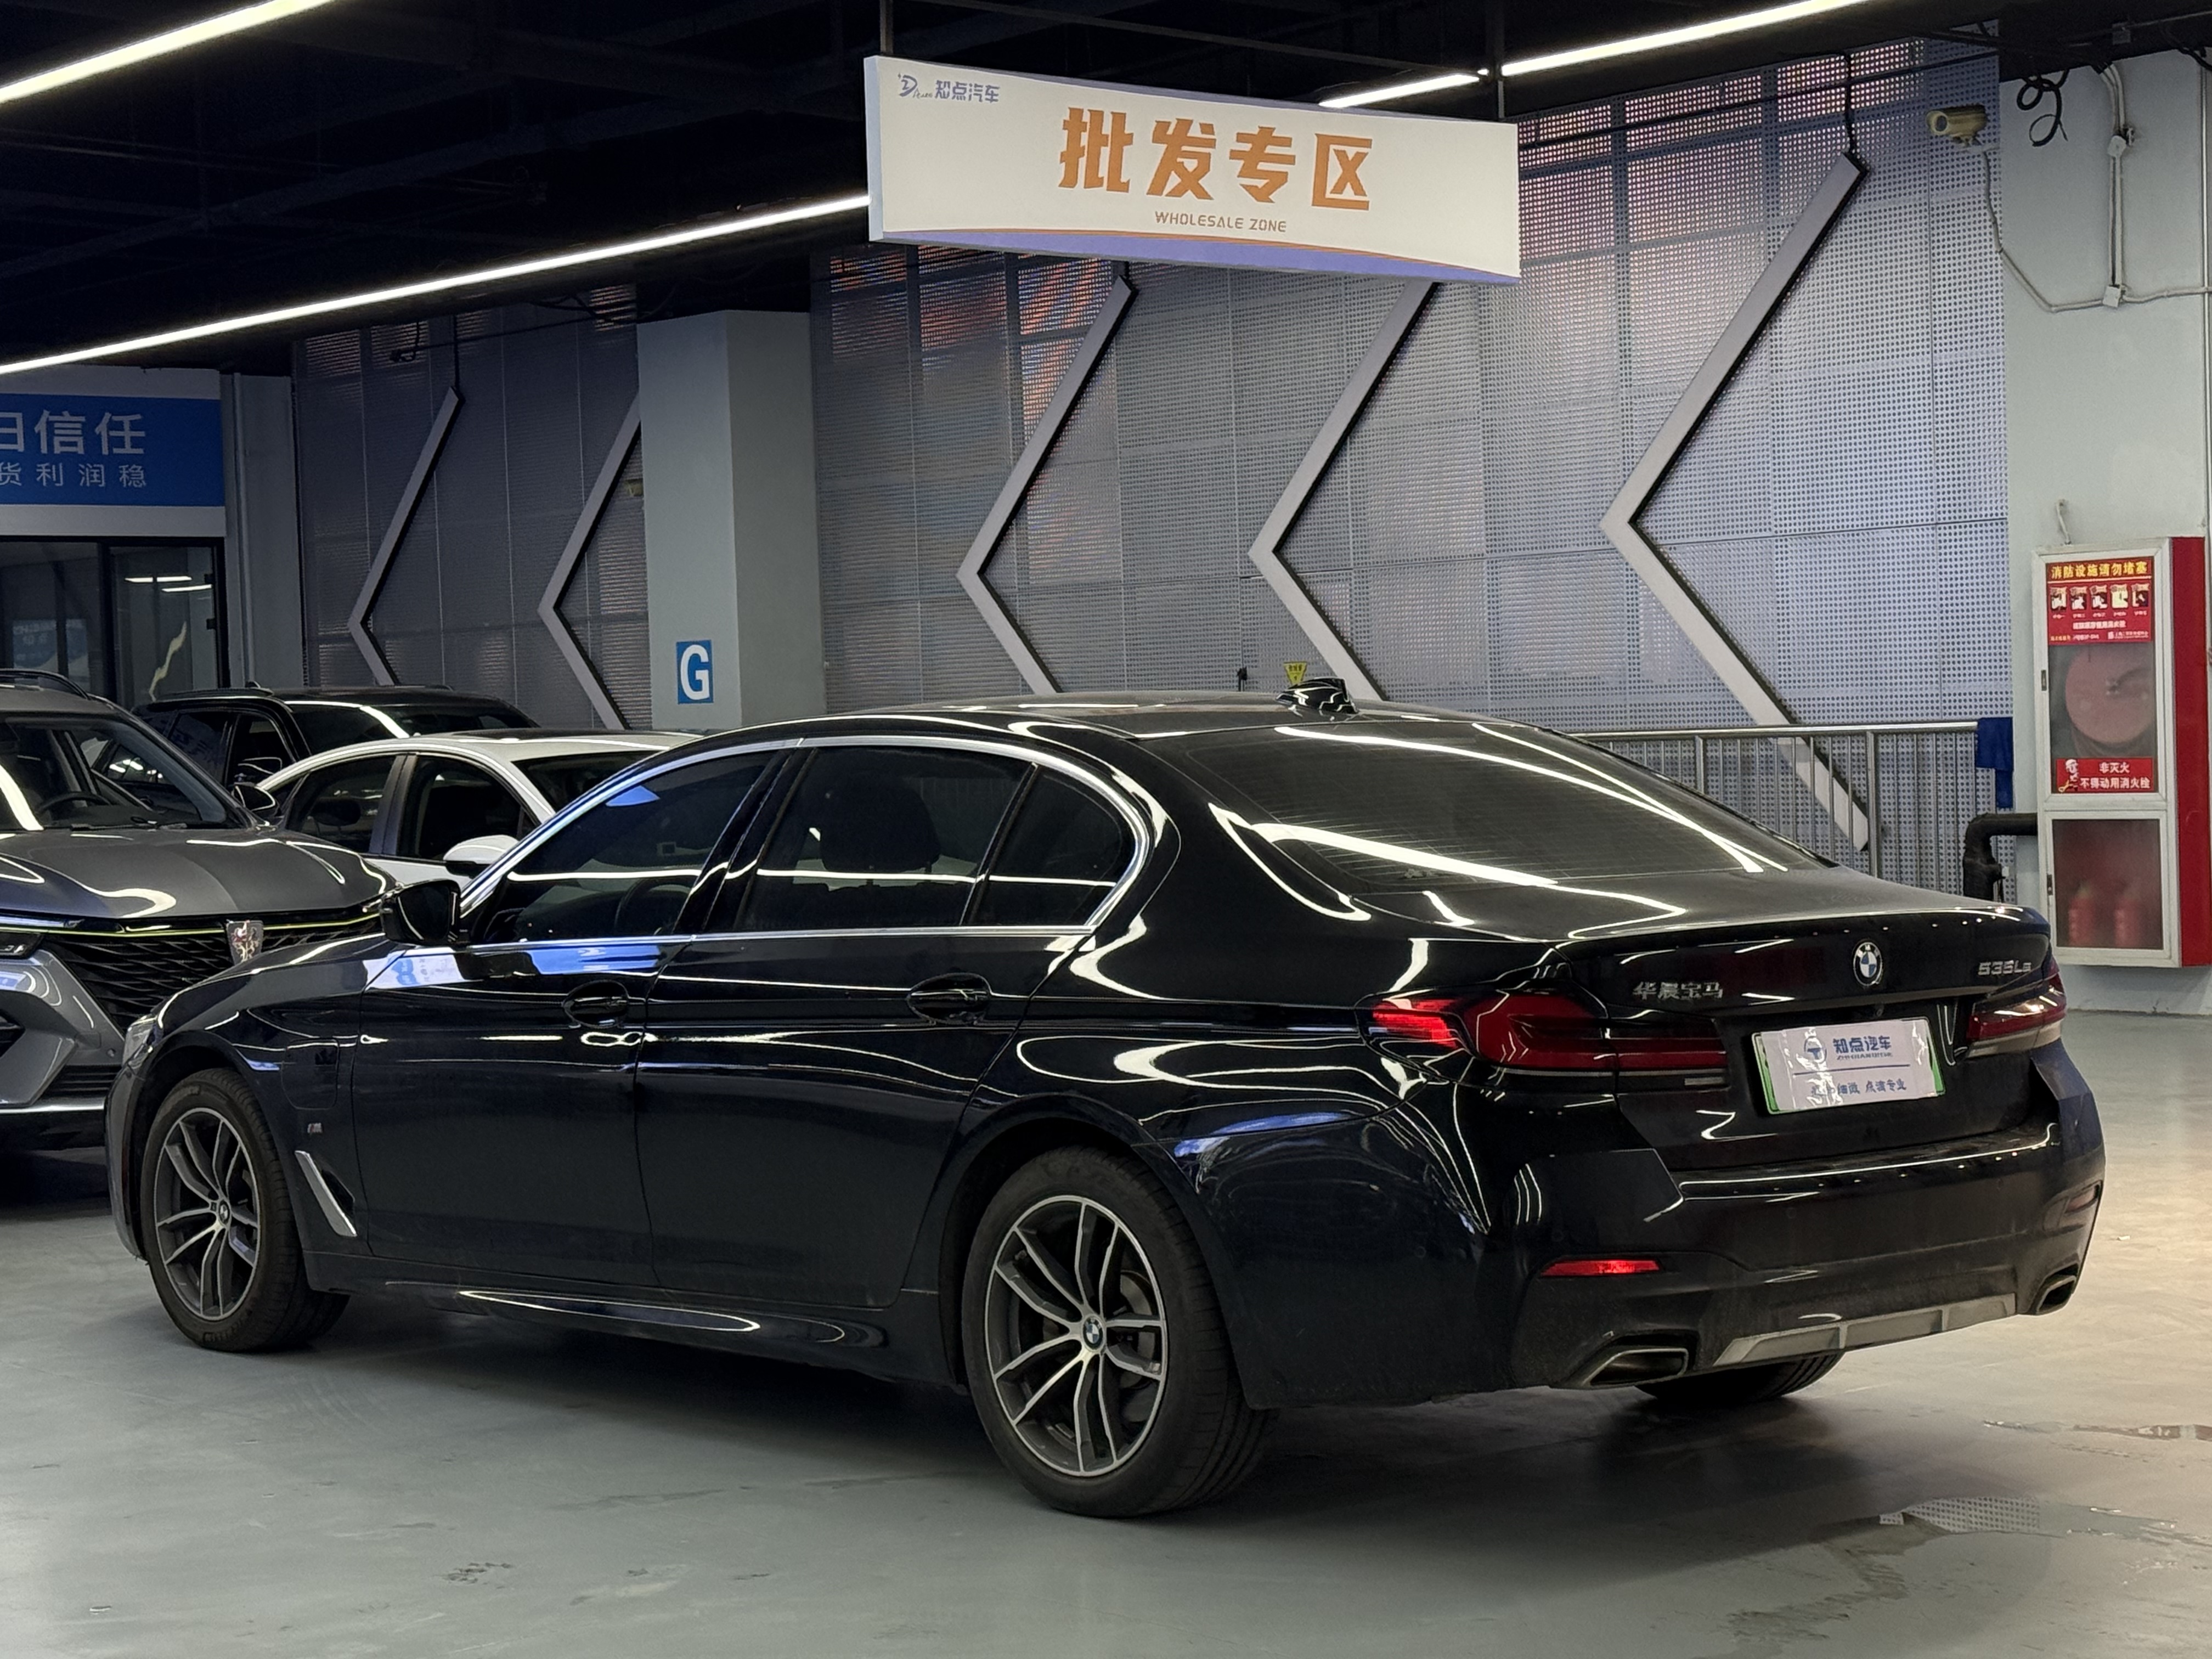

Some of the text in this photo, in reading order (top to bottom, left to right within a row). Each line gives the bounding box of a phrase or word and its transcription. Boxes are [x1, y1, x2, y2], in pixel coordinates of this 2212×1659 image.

[934, 80, 1000, 103] 知点汽车
[1058, 106, 1373, 211] 批发专区
[1154, 211, 1286, 233] WHOLESALE ZONE
[2051, 561, 2147, 579] 消防设施请勿堵塞
[681, 644, 710, 700] G
[2099, 761, 2130, 774] 非灭火
[1632, 981, 1724, 1000] 华晨宝马
[1832, 1035, 1892, 1053] 知点汽车
